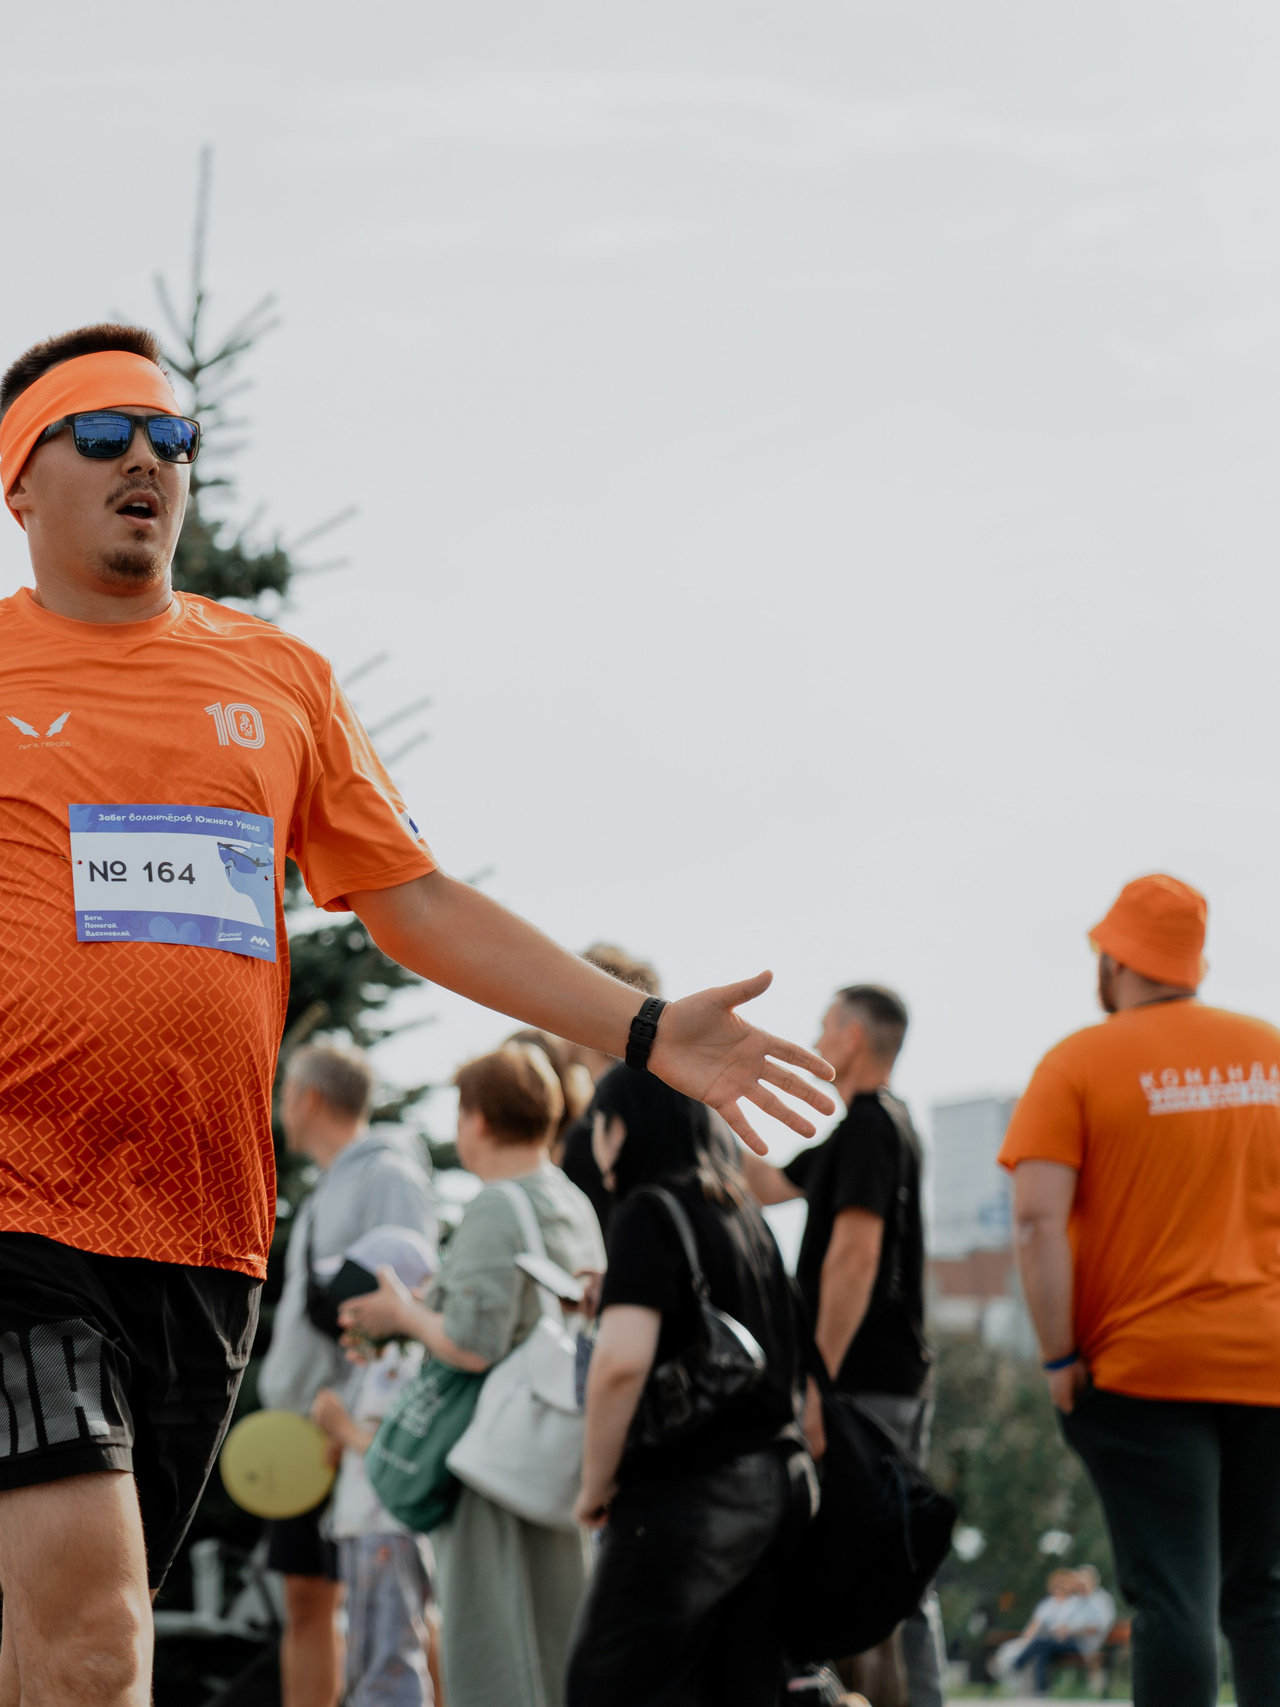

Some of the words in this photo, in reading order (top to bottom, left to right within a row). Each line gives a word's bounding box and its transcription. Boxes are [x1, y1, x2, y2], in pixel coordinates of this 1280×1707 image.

[204, 702, 266, 750] 10
[18, 742, 39, 751] ЛИГА
[98, 813, 127, 821] Забег
[128, 813, 193, 823] волонтёров
[195, 815, 233, 827] Южного
[235, 820, 261, 832] Урала
[142, 861, 196, 884] 164
